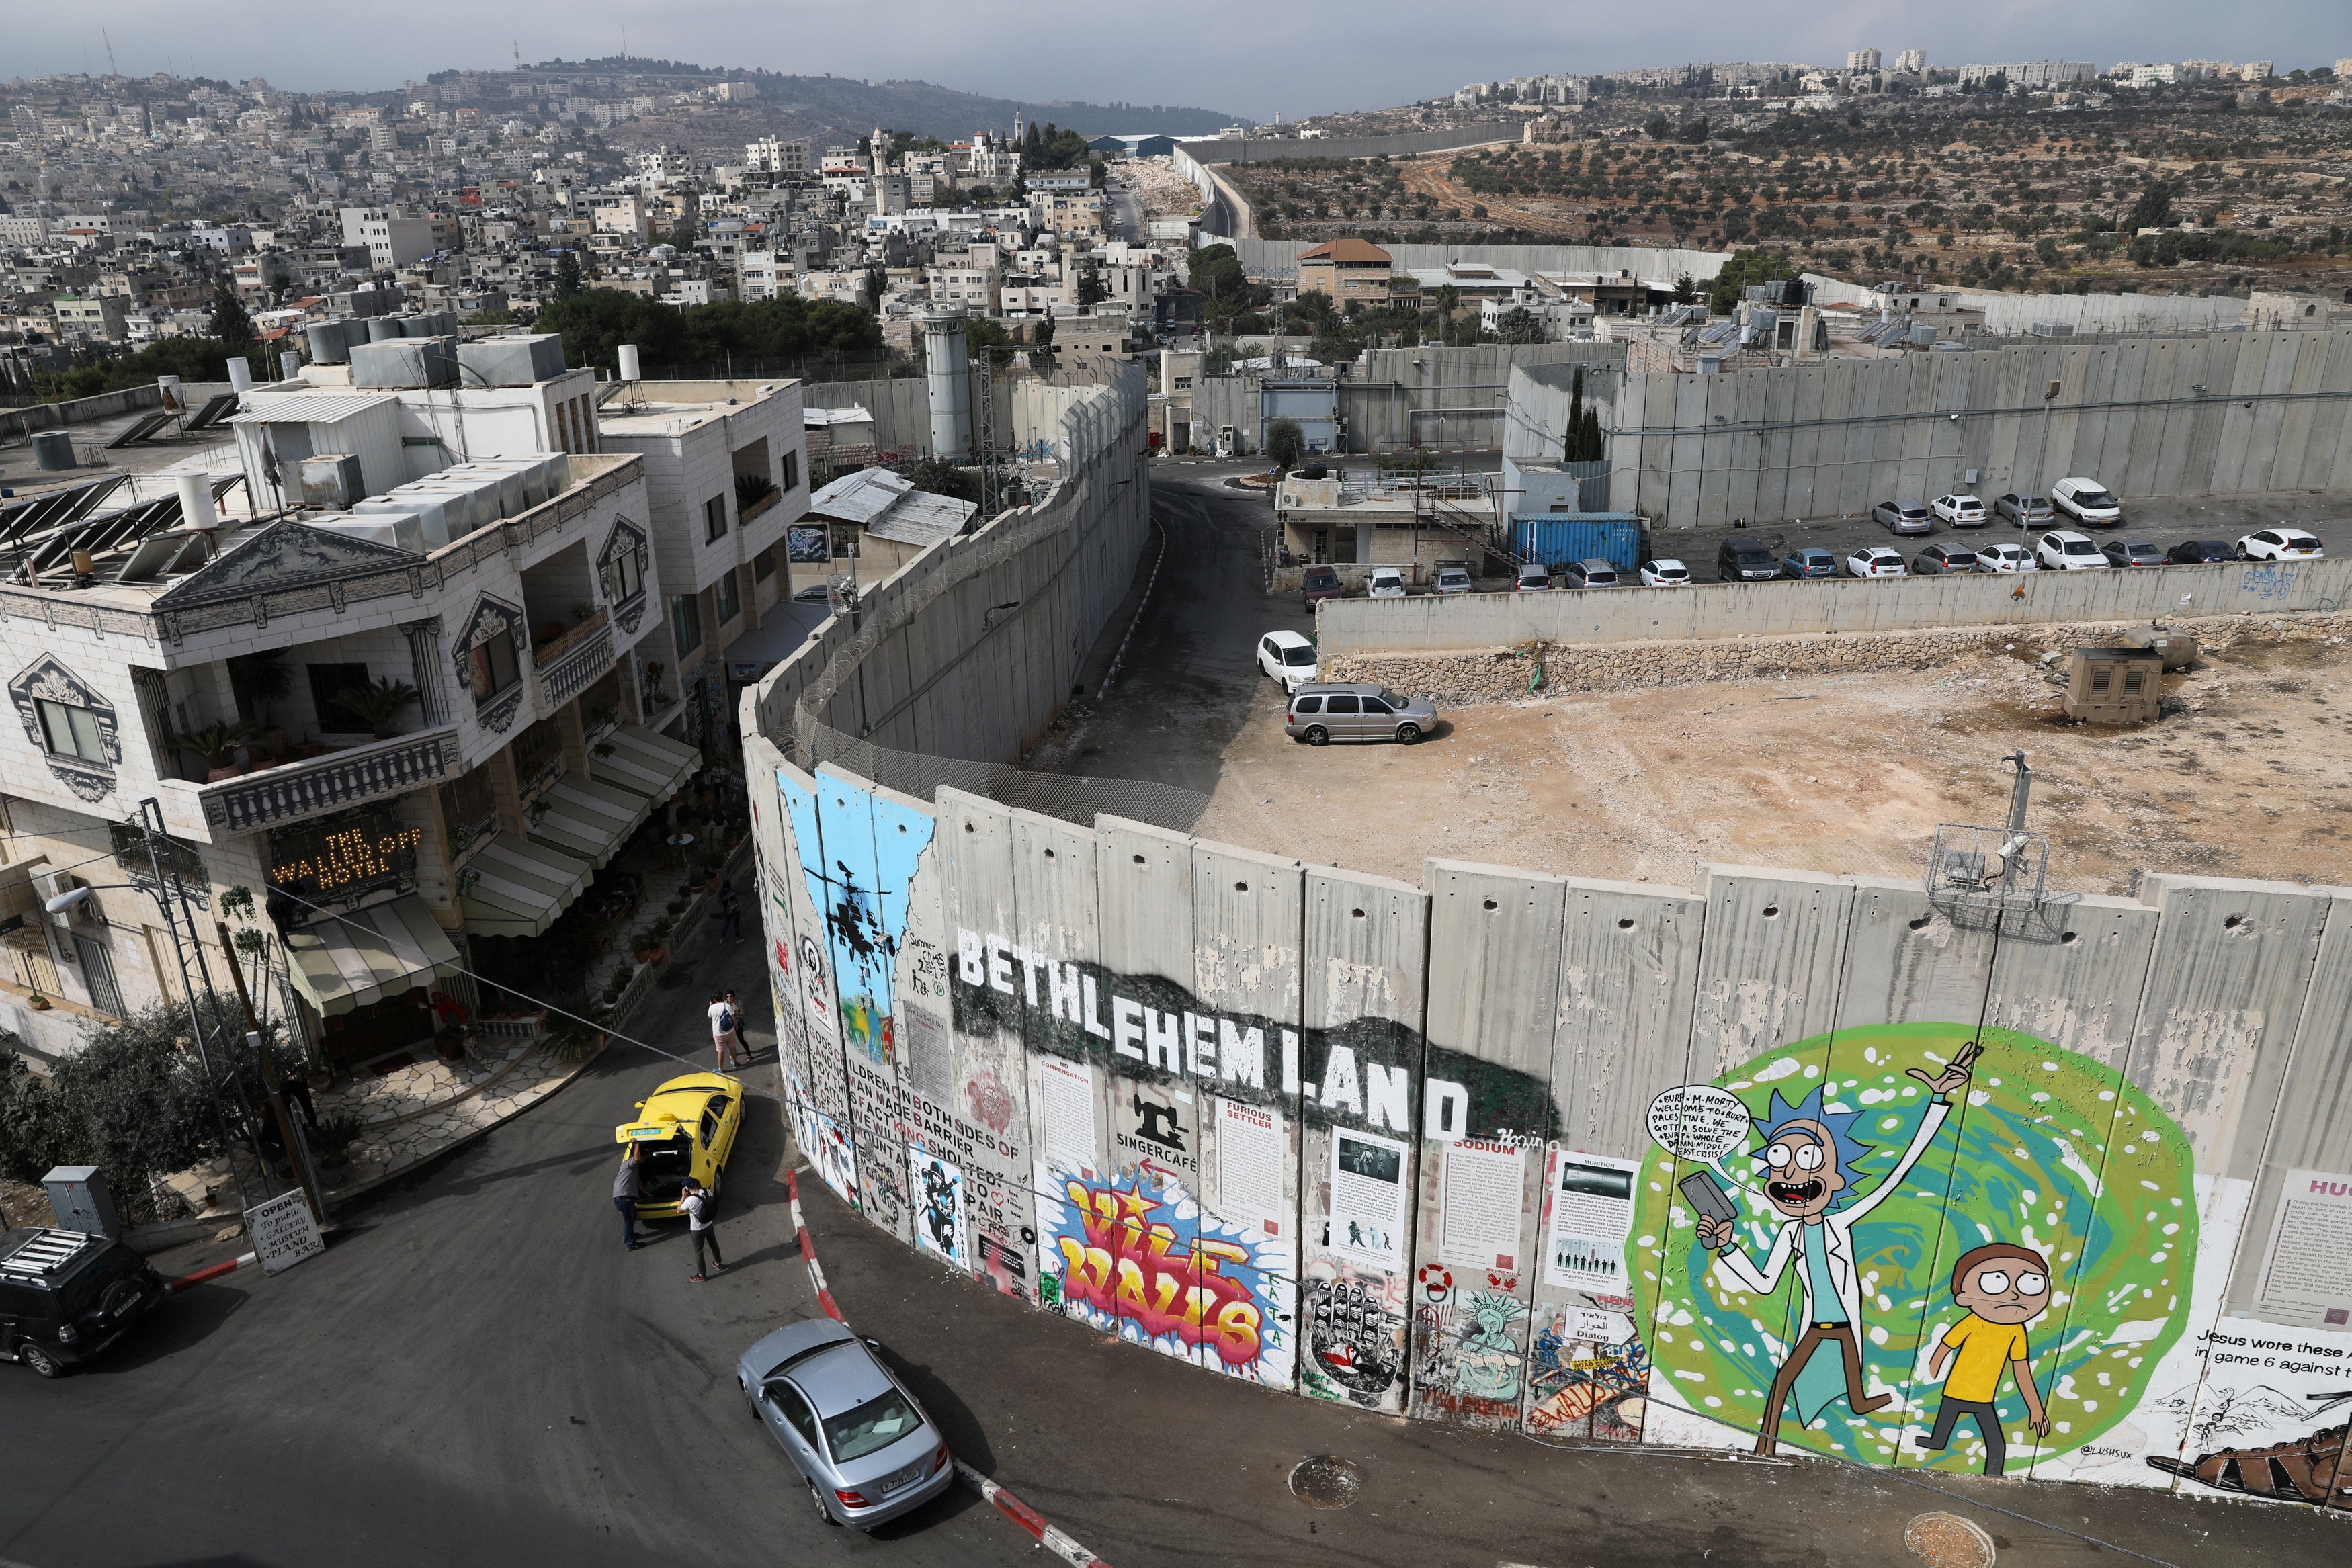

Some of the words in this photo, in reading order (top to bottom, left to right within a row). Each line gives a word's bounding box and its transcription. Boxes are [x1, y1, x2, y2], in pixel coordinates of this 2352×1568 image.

[325, 828, 363, 851] THE
[271, 843, 373, 885] WALLED
[378, 828, 422, 854] OFF
[318, 857, 391, 890] HOTEL
[909, 932, 936, 951] Summer
[915, 1018, 935, 1032] Freedom
[958, 928, 1263, 1090] BETHLEHEM
[1281, 1029, 1469, 1141] LAND
[1041, 1061, 1089, 1084] COMPENSATION
[834, 1048, 890, 1096] CHILDREN
[892, 1085, 911, 1106] ON
[913, 1096, 952, 1128] BOTH
[955, 1118, 996, 1150] SIDES
[998, 1141, 1019, 1161] OF
[1227, 1102, 1271, 1121] FURIOUS
[1655, 1104, 1706, 1113] WELCOME
[1706, 1107, 1720, 1115] TO
[1692, 1094, 1740, 1110] M-MORTY
[848, 1076, 872, 1098] MAN
[876, 1090, 911, 1122] MADE
[913, 1113, 974, 1159] BARRIER
[1227, 1110, 1271, 1130] SETTLER
[1712, 1118, 1730, 1127] WE
[1654, 1123, 1688, 1133] GOTTA
[1692, 1124, 1720, 1134] SOLVE
[1721, 1129, 1741, 1137] THE
[1693, 1133, 1725, 1143] WHOLE
[1340, 1133, 1361, 1141] SETTLERS
[1371, 1140, 1400, 1151] SETTLEMENTS
[1453, 1139, 1515, 1156] SODIUM
[1667, 1139, 1693, 1149] DAMN
[1696, 1141, 1730, 1151] MIDDLE
[853, 1106, 872, 1129] WE
[966, 1178, 988, 1199] TO
[1678, 1147, 1695, 1156] EAST
[1696, 1149, 1724, 1159] CRISIS!
[1584, 1160, 1615, 1168] MUNITION
[2309, 1180, 2352, 1196] HU
[261, 1199, 293, 1217] OPEN
[261, 1221, 273, 1230] To
[274, 1208, 302, 1227] public
[266, 1216, 306, 1240] GALLERY
[269, 1225, 310, 1249] MUSEUM
[270, 1235, 308, 1259] PIANO
[293, 1240, 319, 1258] BAR
[1058, 1235, 1262, 1364] WALLS
[1577, 1330, 1609, 1342] Dialog
[2197, 1329, 2246, 1346] Jesus
[2251, 1338, 2293, 1352] wore
[2297, 1342, 2343, 1358] these
[2195, 1346, 2208, 1358] in
[2214, 1352, 2259, 1366] game
[2264, 1357, 2275, 1368] 6
[2279, 1360, 2341, 1377] against
[2080, 1444, 2133, 1460] @LUSHSUX
